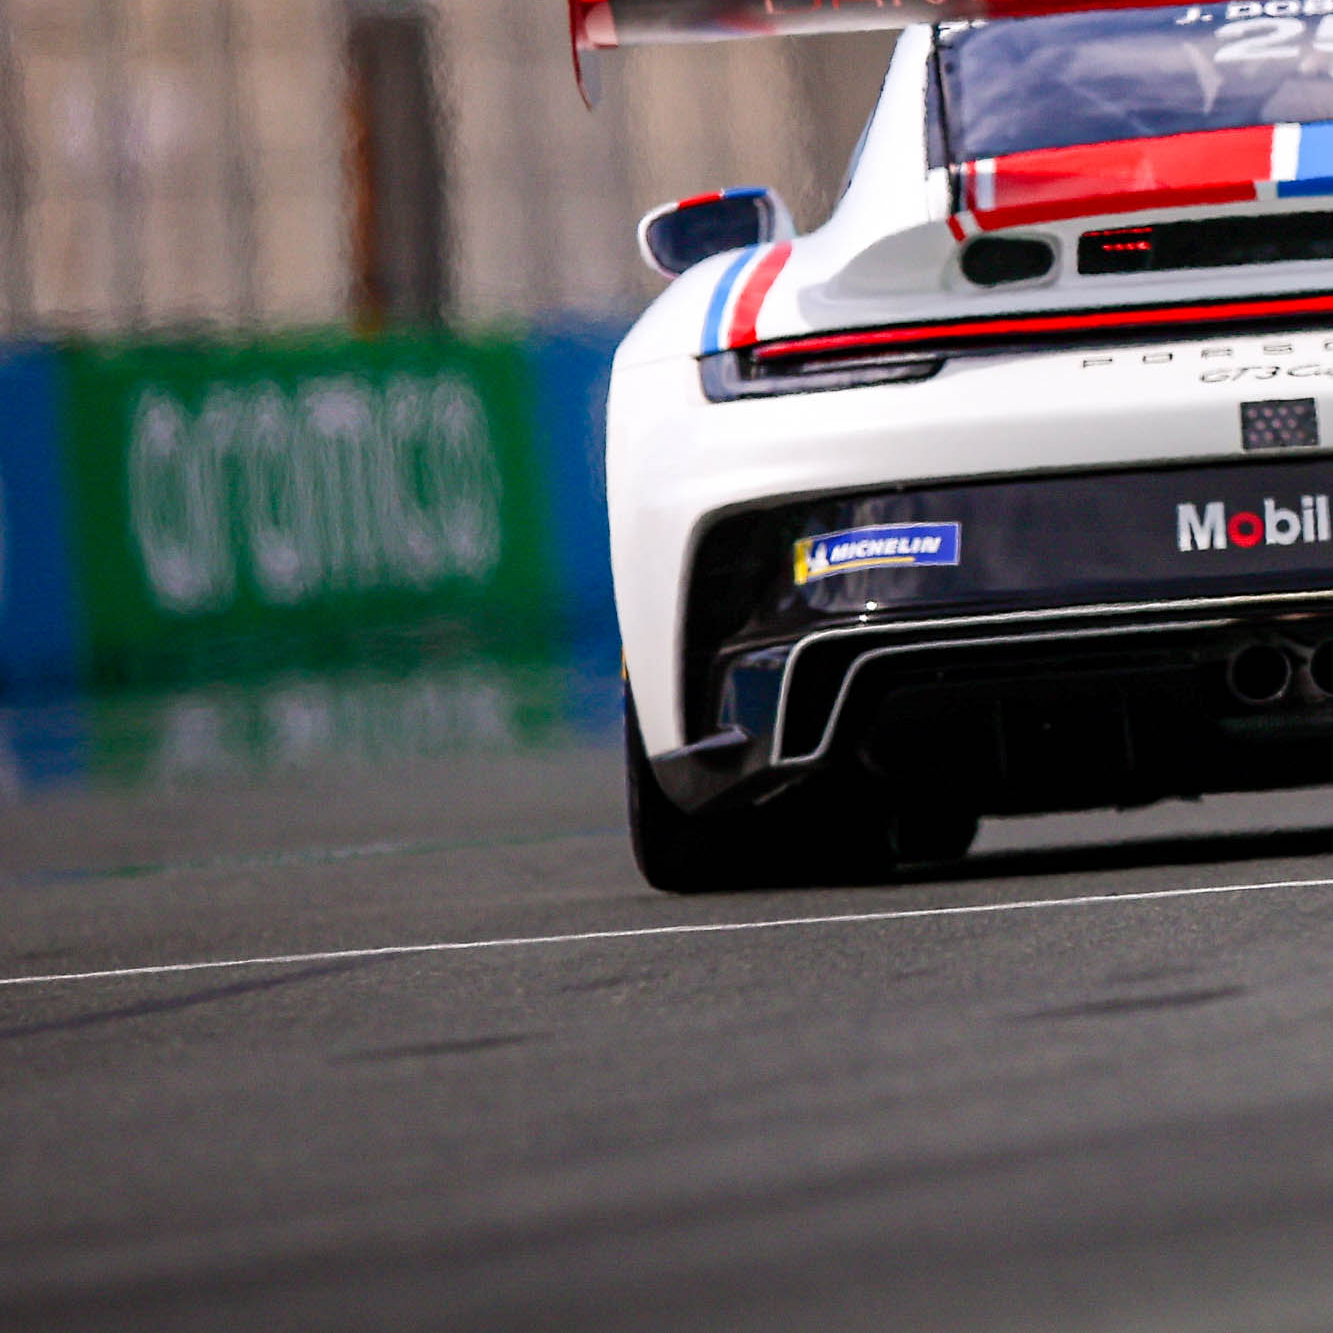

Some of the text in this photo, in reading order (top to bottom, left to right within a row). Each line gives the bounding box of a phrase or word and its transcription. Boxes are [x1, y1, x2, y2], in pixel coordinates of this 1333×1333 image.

[1199, 365, 1281, 384] GT3
[1177, 494, 1332, 552] Mobil
[829, 535, 943, 563] MICHELIN
